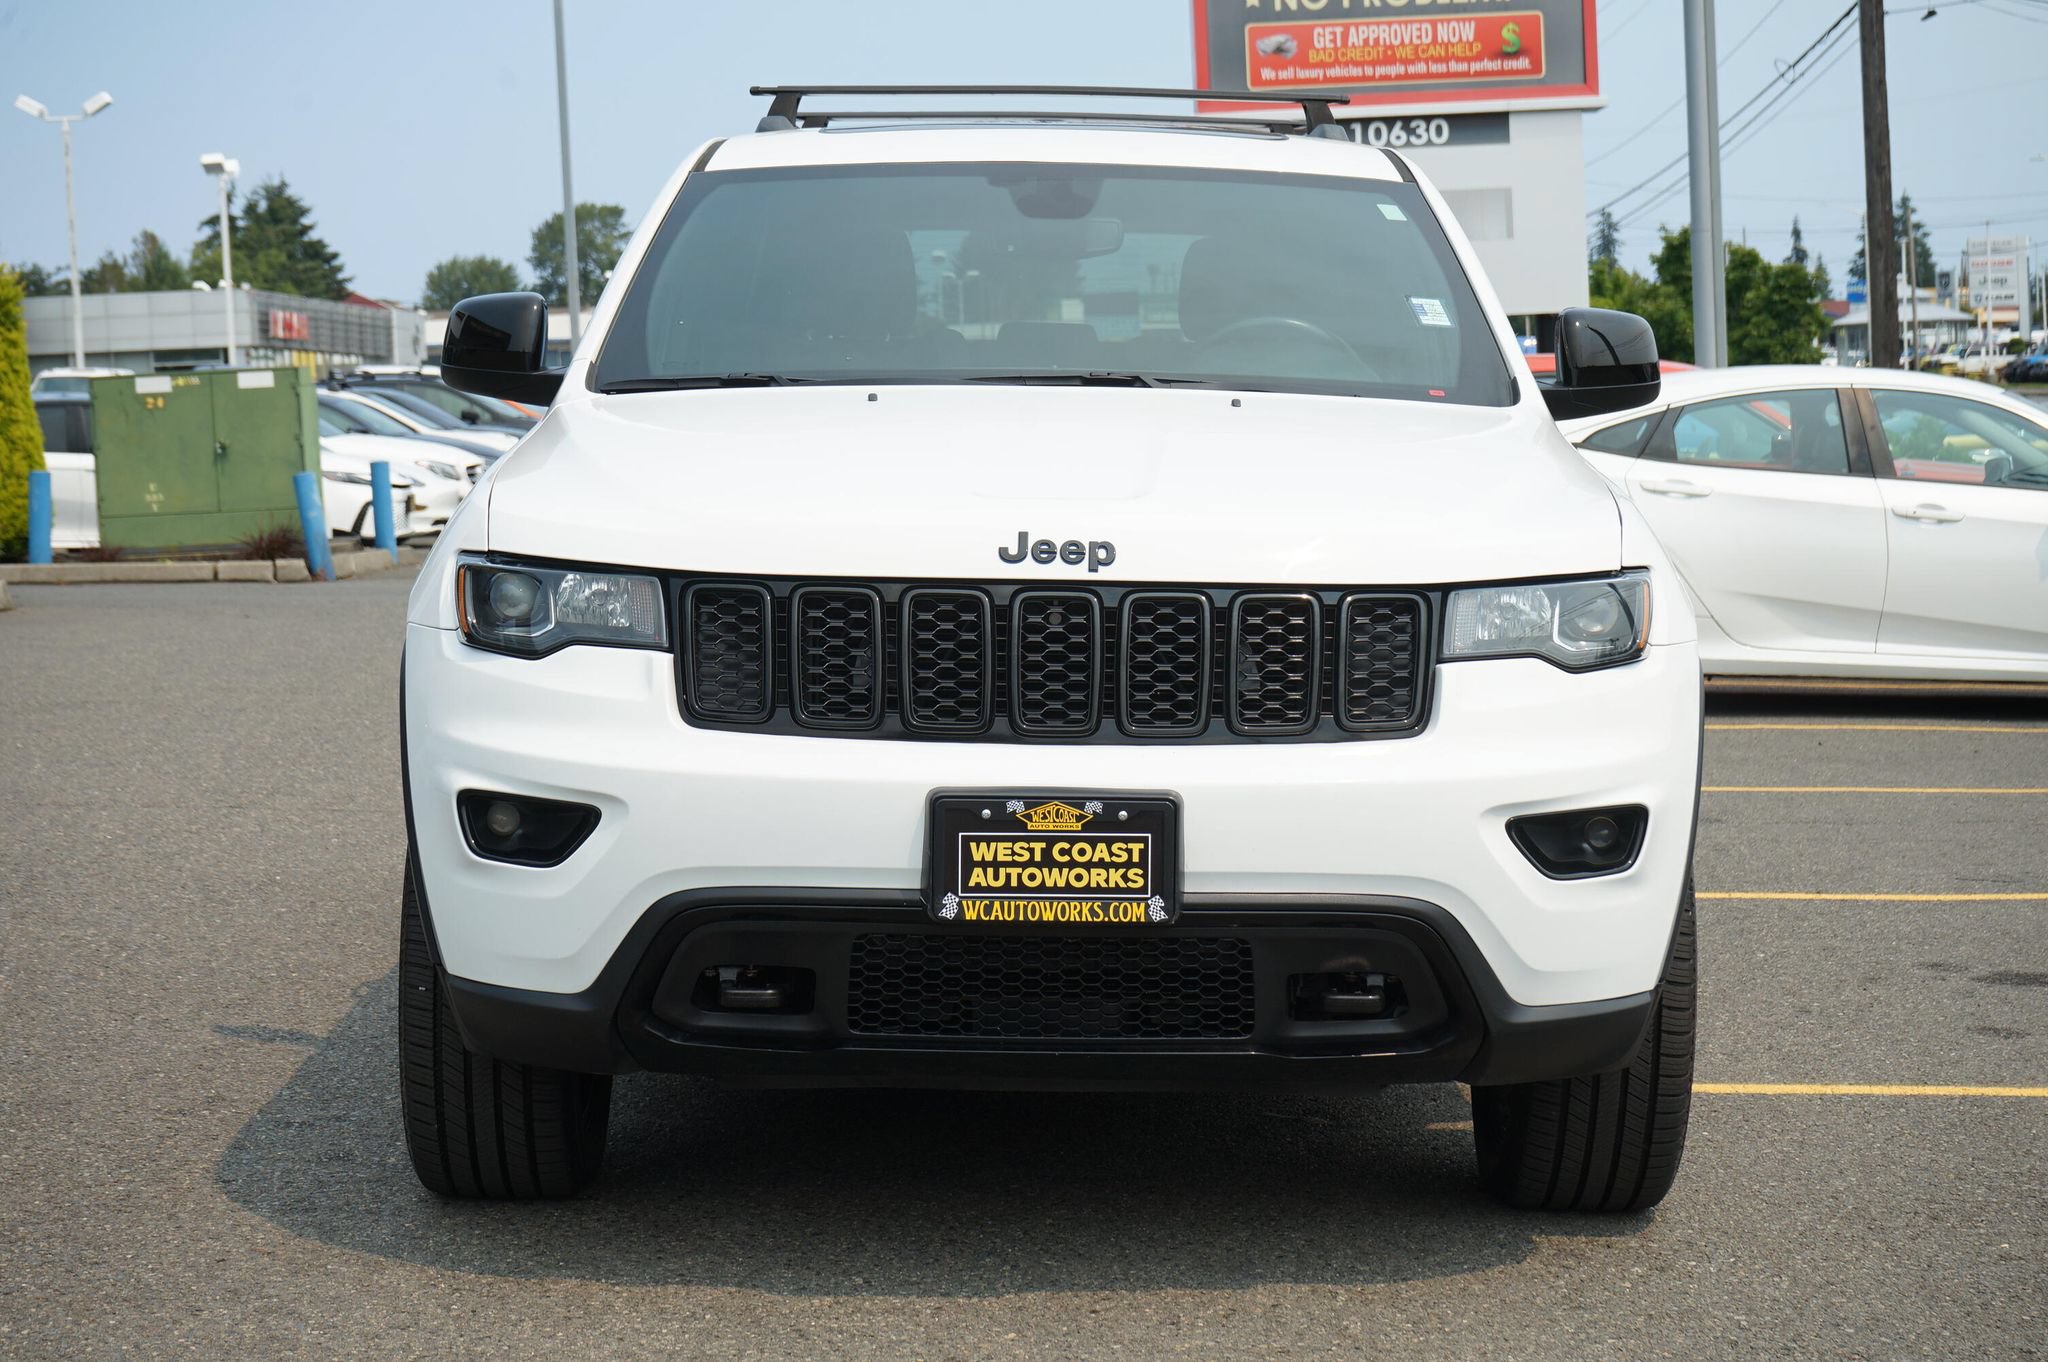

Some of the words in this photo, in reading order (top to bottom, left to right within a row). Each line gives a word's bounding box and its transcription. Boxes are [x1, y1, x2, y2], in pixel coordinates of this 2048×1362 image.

[1313, 27, 1344, 48] GET
[1348, 22, 1432, 47] APPROVED
[1437, 20, 1476, 43] NOW
[1309, 48, 1335, 63] BAD
[1338, 46, 1384, 62] CREDIT
[1394, 45, 1415, 59] WE
[1418, 44, 1445, 58] CAN
[1449, 42, 1482, 57] HELP
[1260, 67, 1275, 81] We
[1277, 66, 1294, 80] sell
[1296, 66, 1324, 81] luxury
[1325, 64, 1363, 79] vehicles
[1364, 65, 1373, 77] to
[1375, 62, 1405, 78] people
[1407, 61, 1427, 75] with
[1428, 60, 1448, 73] less
[1449, 59, 1468, 72] than
[1469, 57, 1502, 75] perfect
[1350, 117, 1450, 147] 10630
[998, 531, 1116, 573] Jeep
[969, 841, 1046, 862] WEST
[1052, 842, 1145, 863] COAST
[968, 867, 1145, 888] AUTOWORKS
[962, 900, 1146, 923] WCAUTOWORKS.COM
